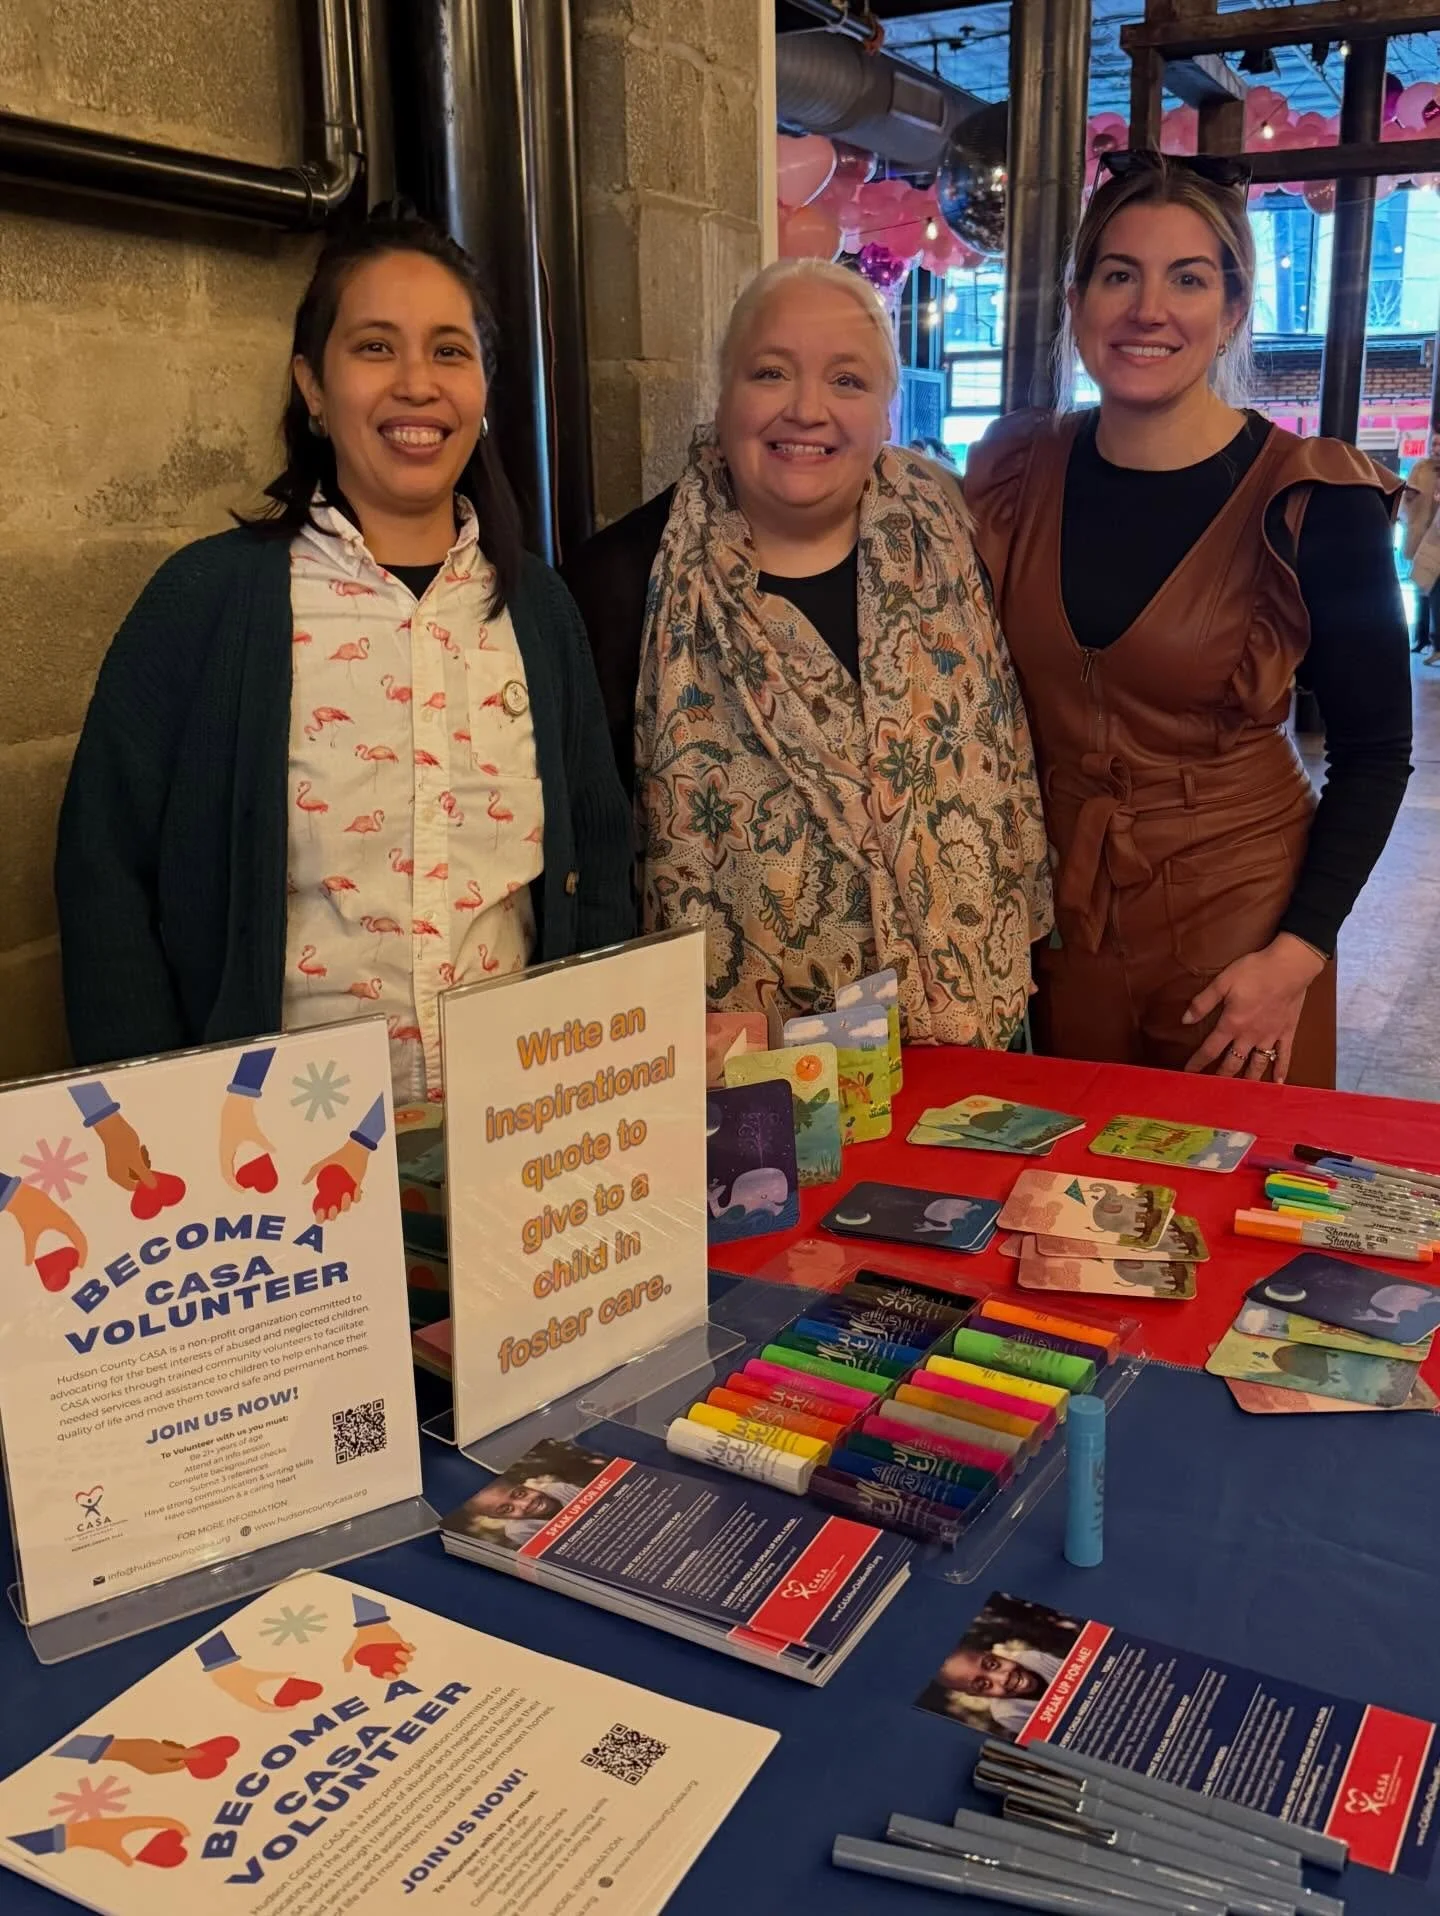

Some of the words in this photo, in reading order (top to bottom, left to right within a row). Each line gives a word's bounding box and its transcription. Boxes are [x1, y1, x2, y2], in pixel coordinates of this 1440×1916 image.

[518, 1017, 603, 1070] Write
[609, 1006, 646, 1040] an
[486, 1046, 675, 1142] inspirational
[522, 1131, 610, 1192] quote
[618, 1118, 647, 1152] to
[522, 1196, 588, 1254] give
[594, 1181, 625, 1216] to
[630, 1173, 649, 1201] a
[71, 1214, 286, 1314] BECOME
[293, 1224, 324, 1254] A
[145, 1256, 274, 1305] CASA
[532, 1235, 608, 1300] child
[615, 1230, 641, 1266] in
[57, 1368, 97, 1384] Hudson
[100, 1358, 137, 1372] County
[139, 1348, 167, 1361] CASA
[187, 1329, 236, 1348] non-profit
[238, 1312, 297, 1334] organization
[299, 1296, 350, 1317] committed
[352, 1294, 362, 1302] to
[65, 1261, 349, 1354] VOLUNTEER
[497, 1306, 592, 1374] foster
[597, 1274, 671, 1325] care.
[50, 1379, 107, 1400] advocating
[110, 1375, 123, 1384] for
[126, 1369, 143, 1379] the
[146, 1362, 167, 1374] best
[170, 1351, 212, 1367] interests
[214, 1345, 223, 1354] of
[226, 1334, 261, 1351] abused
[263, 1328, 281, 1341] and
[283, 1315, 329, 1335] neglected
[57, 1425, 92, 1441] quality
[94, 1420, 104, 1430] of
[107, 1417, 122, 1426] life
[124, 1409, 144, 1421] and
[146, 1402, 174, 1415] move
[176, 1394, 203, 1406] them
[205, 1381, 239, 1398] toward
[241, 1375, 261, 1387] safe
[263, 1368, 281, 1381] and
[283, 1354, 334, 1376] permanent
[336, 1344, 368, 1358] homes.
[59, 1408, 98, 1426] needed
[101, 1398, 141, 1414] services
[143, 1390, 162, 1402] and
[165, 1377, 215, 1396] assistance
[217, 1373, 227, 1381] to
[229, 1361, 268, 1377] children
[270, 1358, 280, 1366] to
[282, 1351, 303, 1361] help
[304, 1338, 344, 1355] enhance
[346, 1332, 367, 1343] their
[60, 1397, 89, 1412] CASA
[91, 1389, 122, 1403] works
[124, 1376, 165, 1394] through
[168, 1364, 203, 1381] trained
[205, 1350, 261, 1371] community
[263, 1335, 312, 1354] volunteers
[313, 1331, 323, 1339] to
[325, 1320, 364, 1335] facilitate
[145, 1416, 199, 1444] JOIN
[204, 1407, 232, 1426] US
[237, 1386, 298, 1417] NOW!
[173, 1439, 213, 1455] Volunteer
[216, 1432, 235, 1442] with
[248, 1424, 263, 1434] you
[265, 1416, 288, 1427] must:
[76, 1515, 111, 1532] CASA
[177, 1530, 196, 1541] FOR
[197, 1520, 224, 1535] MORE
[226, 1499, 287, 1525] INFORMATION
[546, 1514, 573, 1536] SPEAK
[568, 1504, 582, 1514] UP
[579, 1490, 598, 1504] FOR
[594, 1477, 611, 1491] ME!
[805, 1568, 826, 1588] CASA
[1040, 1694, 1064, 1722] SPEAK
[1056, 1681, 1070, 1694] UP
[1064, 1663, 1082, 1681] FOR
[1076, 1647, 1091, 1663] ME!
[201, 1696, 370, 1858] BECOME
[383, 1679, 425, 1704] A
[224, 1680, 472, 1885] VOLUNTEER
[273, 1724, 393, 1815] CASA
[1373, 1774, 1391, 1800] CASA
[401, 1845, 450, 1894] JOIN
[444, 1820, 476, 1845] US
[470, 1768, 528, 1820] NOW!
